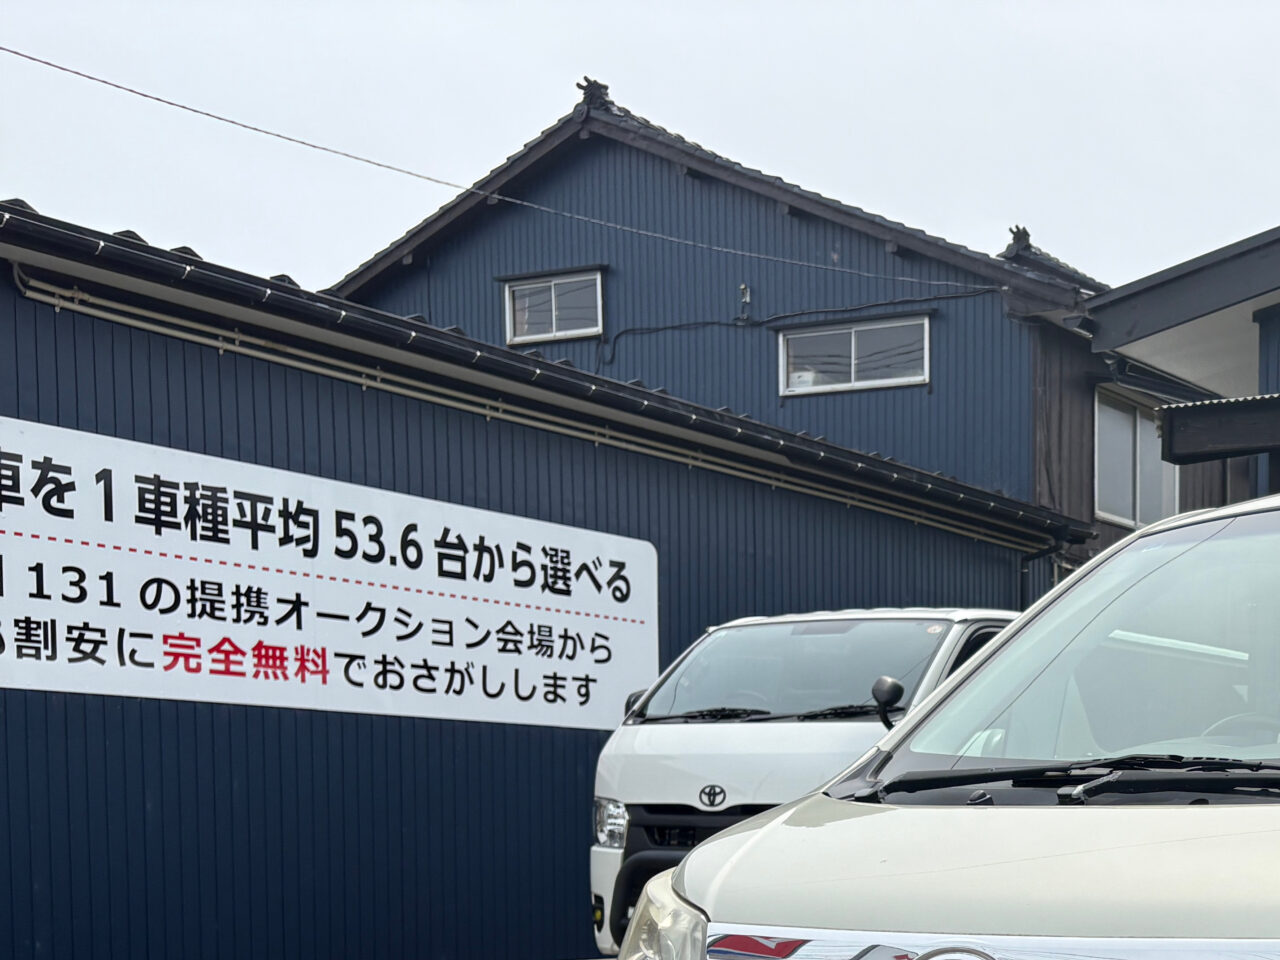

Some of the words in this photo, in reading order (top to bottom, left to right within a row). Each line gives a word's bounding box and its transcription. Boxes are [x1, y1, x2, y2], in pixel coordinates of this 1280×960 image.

[0, 554, 613, 665] 131の提携オークション会場から
[0, 616, 599, 707] 割安に完全無料でおさがしします
